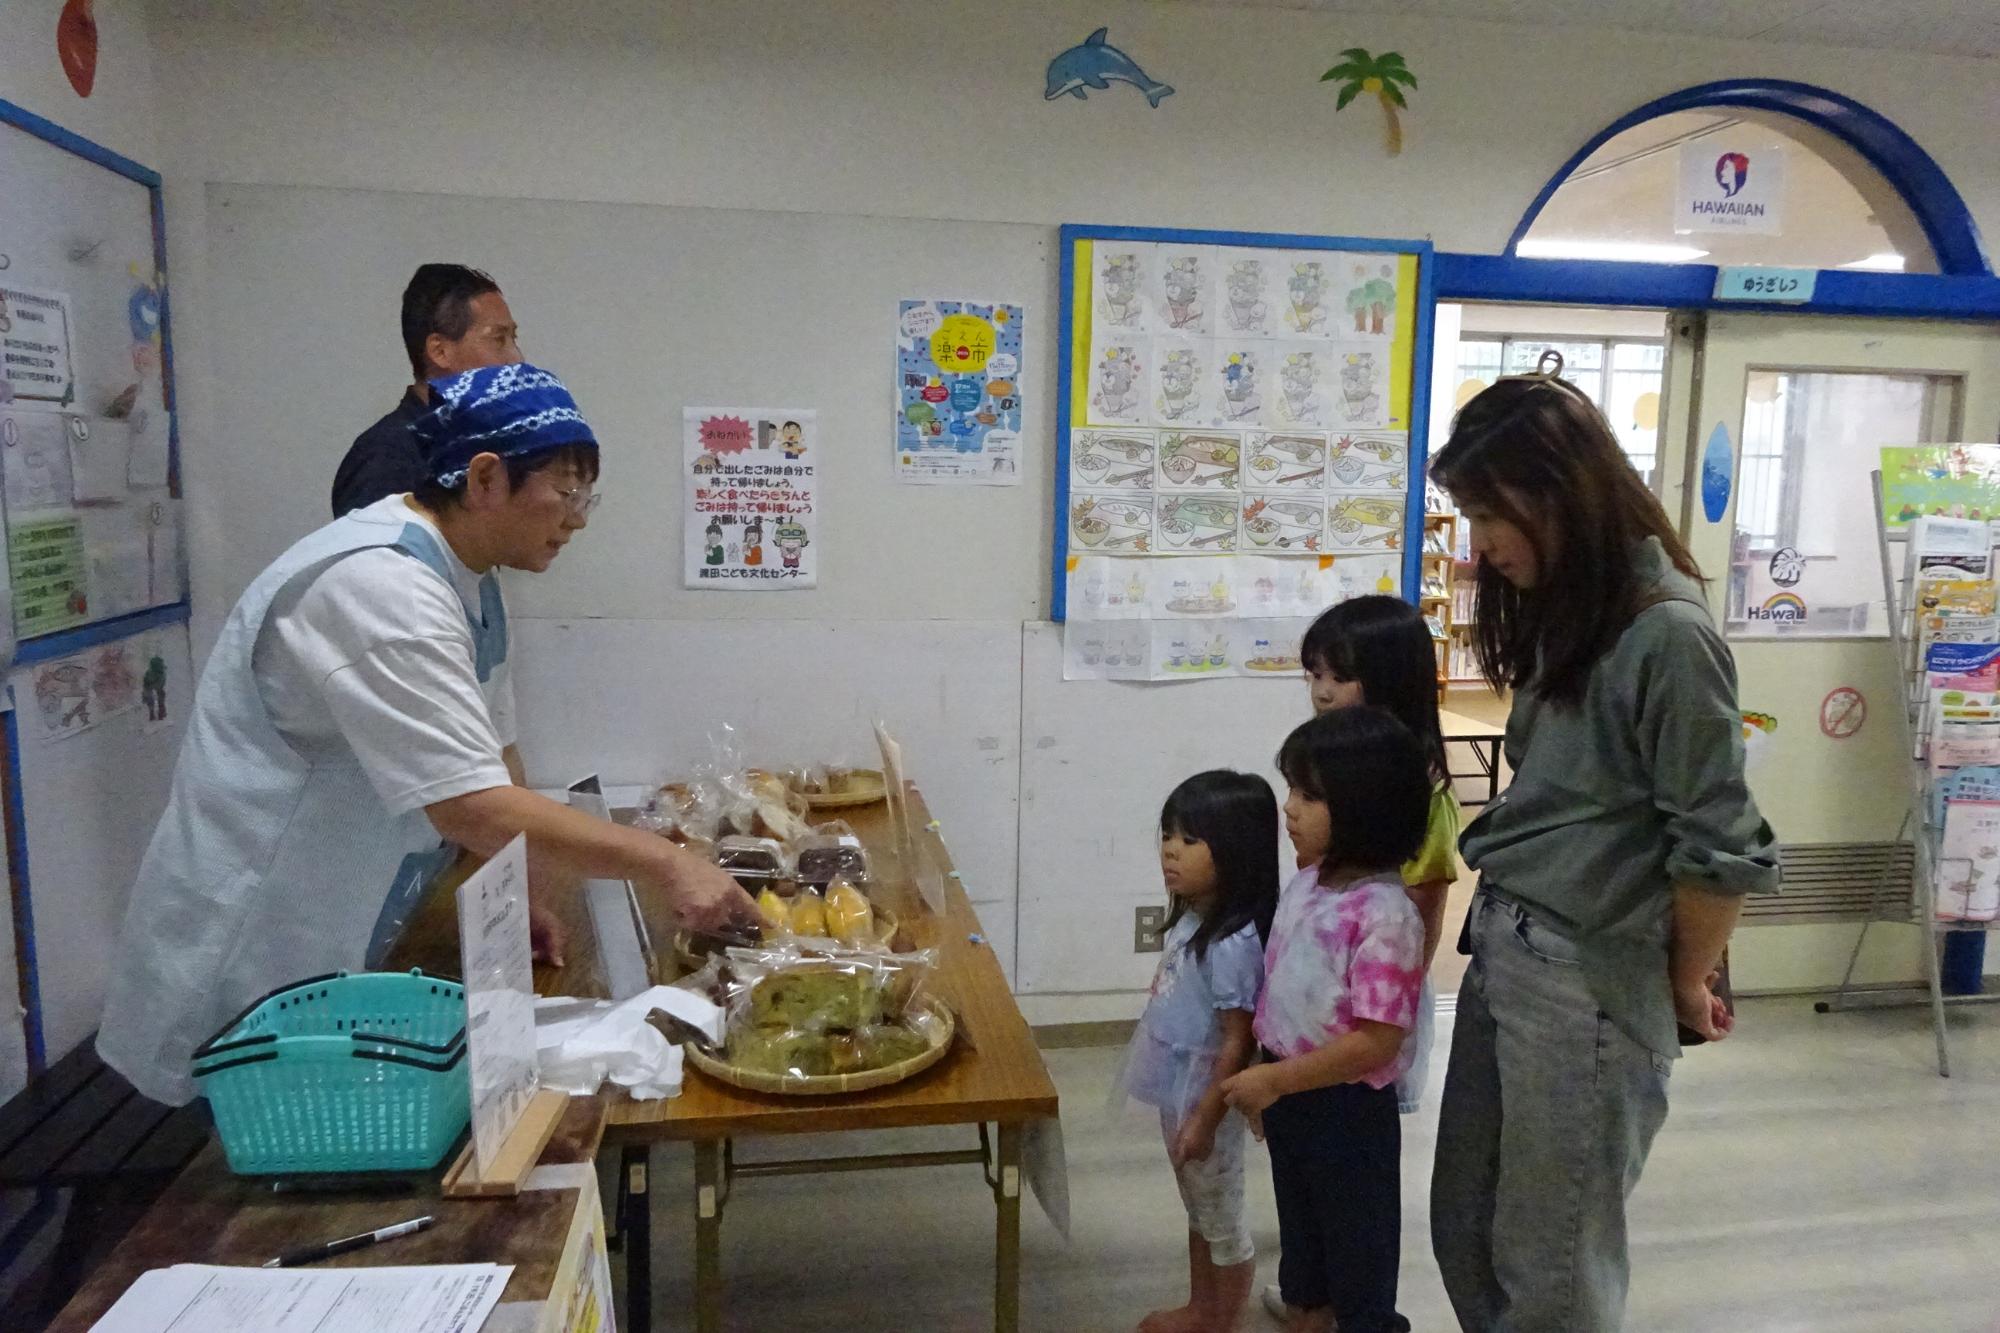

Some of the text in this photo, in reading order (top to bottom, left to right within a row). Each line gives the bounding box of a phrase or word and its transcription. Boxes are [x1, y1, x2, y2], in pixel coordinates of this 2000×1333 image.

[1692, 201, 1765, 217] HAWAIIAN
[1743, 276, 1798, 293] ゆうぎしつ
[693, 465, 814, 477] 自分で出したごみは自分で
[695, 489, 811, 501] 楽しく食べたらきちんと
[695, 503, 813, 514] ごみは持って帰りましょう
[1748, 606, 1807, 620] Hawaii
